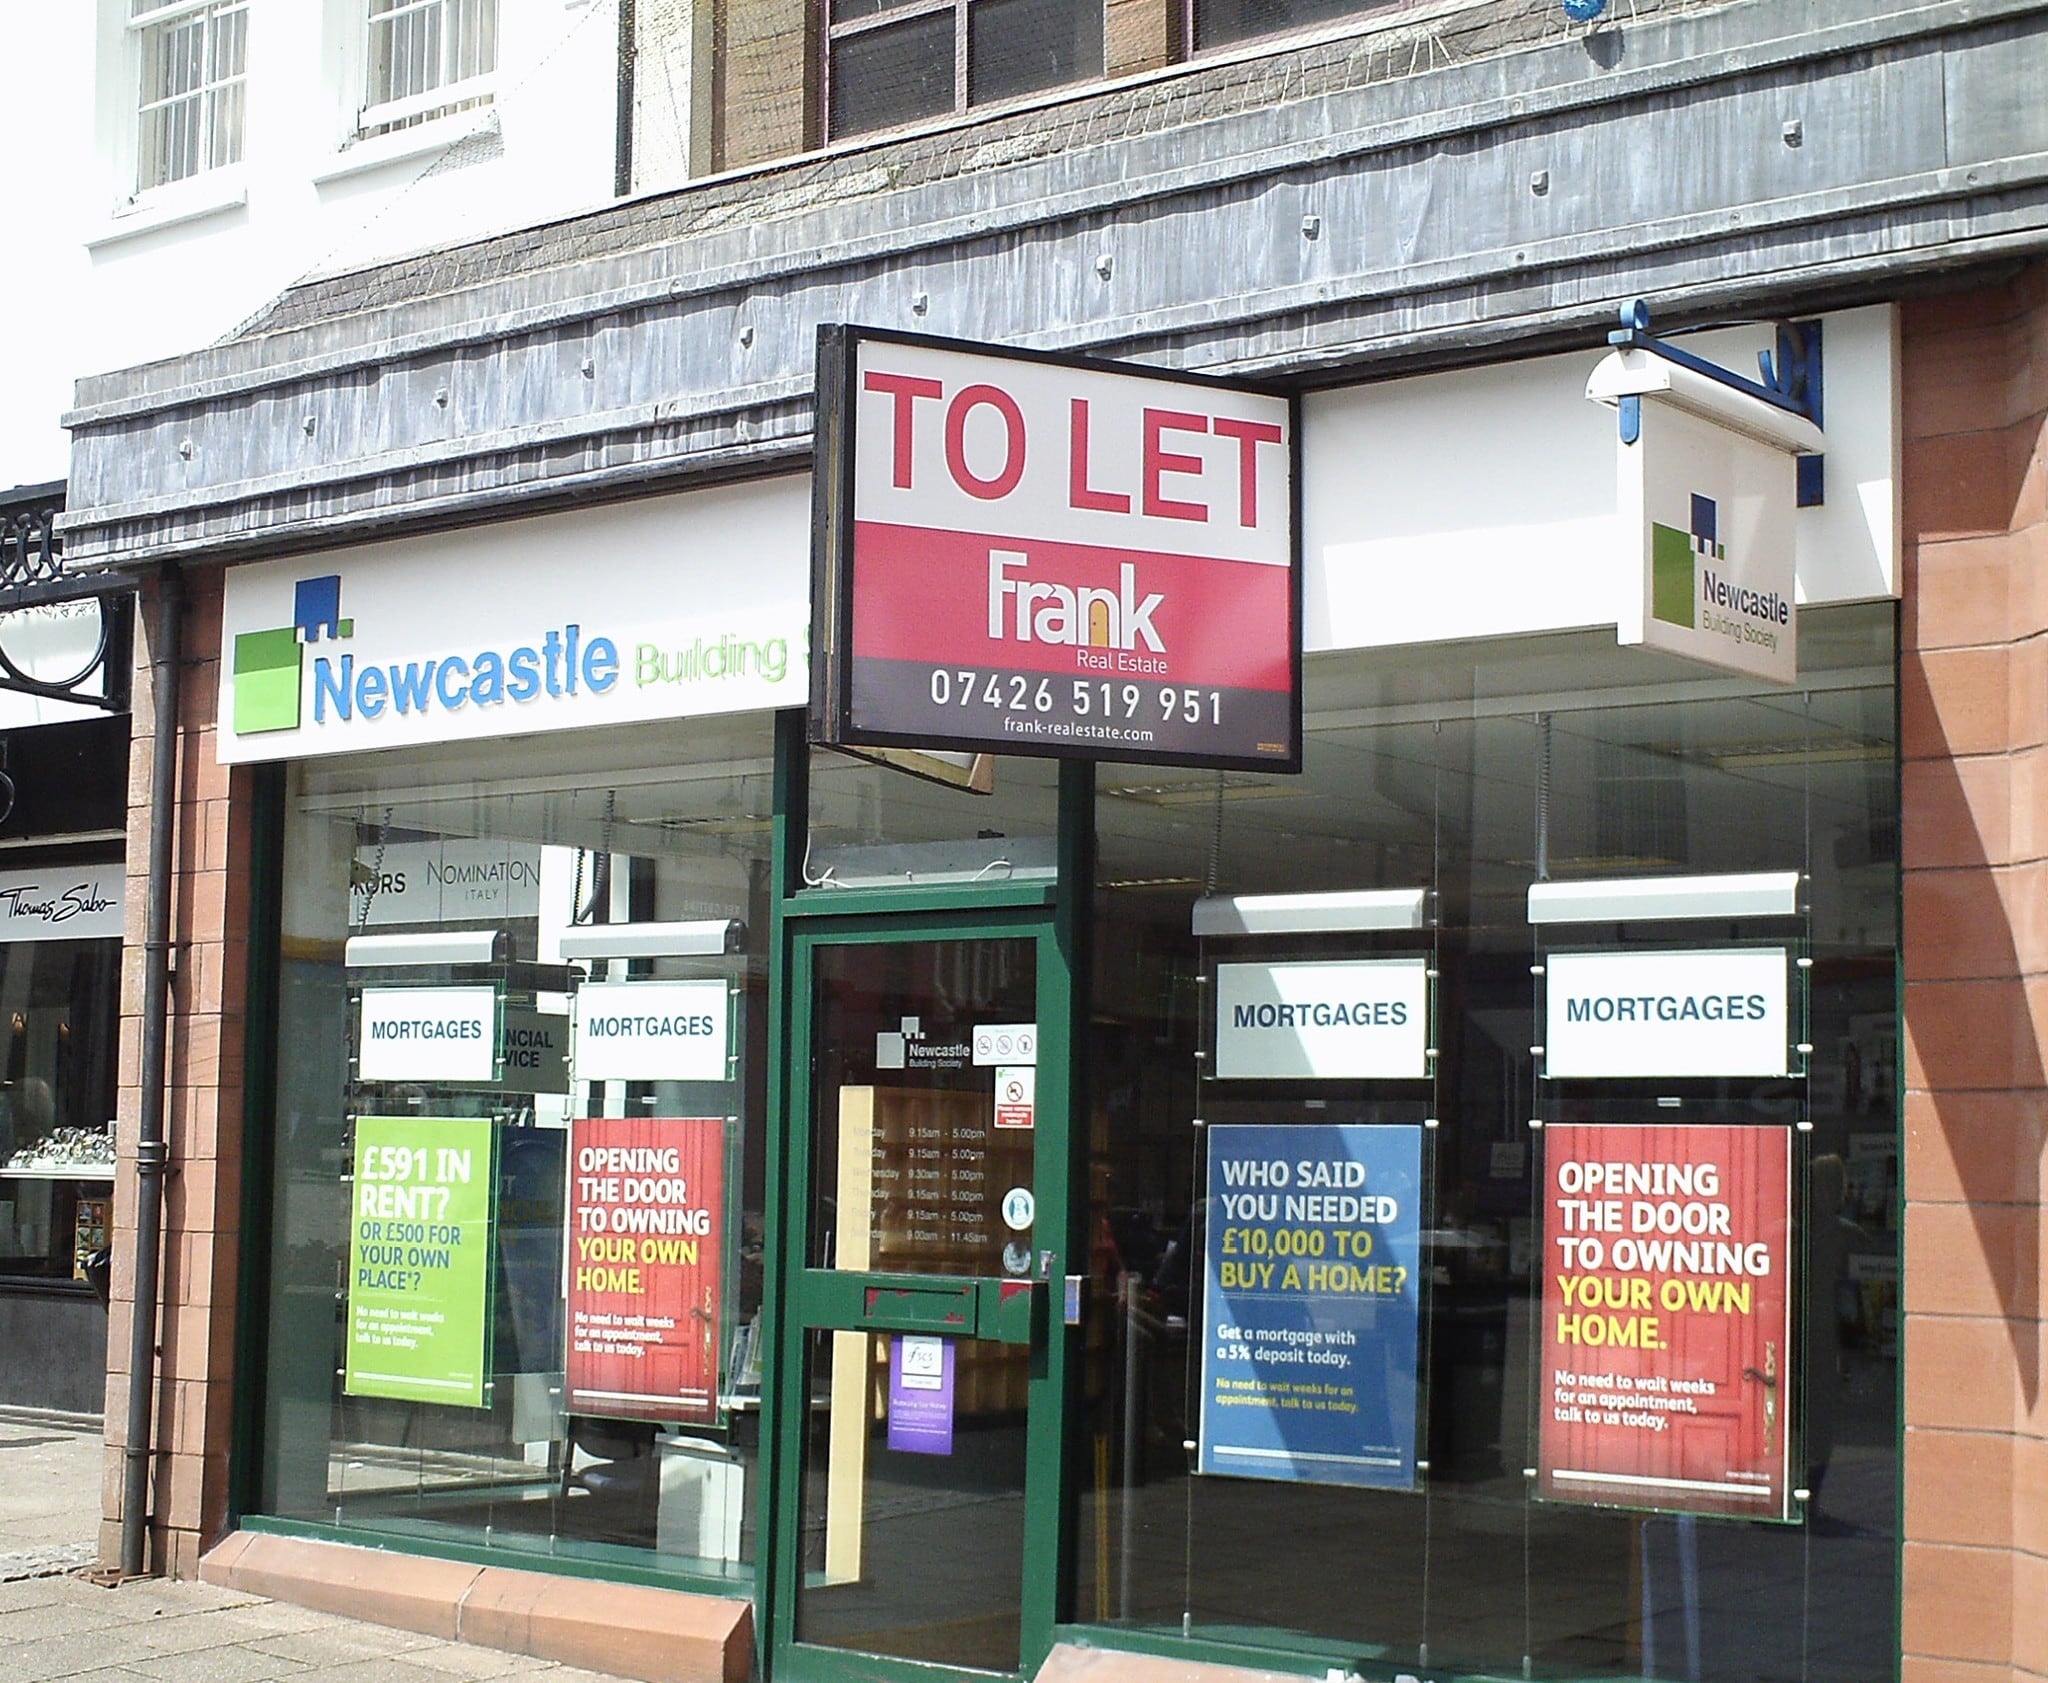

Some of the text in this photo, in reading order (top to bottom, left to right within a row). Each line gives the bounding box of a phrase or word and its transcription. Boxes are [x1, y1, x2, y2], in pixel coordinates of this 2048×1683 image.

[864, 371, 1282, 529] TO LET
[988, 549, 1166, 653] Frank
[1704, 570, 1789, 626] Newcastle
[1703, 610, 1779, 653] Building Society
[314, 623, 621, 724] Newcastle
[635, 632, 788, 690] Building
[1077, 649, 1168, 675] Real Estate
[931, 669, 1221, 725] 07426 519 951
[1003, 717, 1154, 743] frank-realestate.com
[0, 882, 117, 922] Thomas Sabo
[465, 888, 499, 900] ITALY
[1234, 1001, 1408, 1028] MORTGAGES
[1567, 994, 1766, 1023] MORTGAGES
[371, 1019, 483, 1040] MORTGAGES
[588, 1015, 714, 1038] MORTGAGES
[909, 1043, 970, 1058] Newcastle
[909, 1058, 962, 1069] Building Society
[909, 1127, 940, 1138] 9.15am
[952, 1128, 985, 1140] 5.00pm
[361, 1145, 472, 1184] £591 IN
[578, 1147, 680, 1174] OPENING
[908, 1148, 940, 1159] 9.15am
[952, 1149, 984, 1161] 5.00pm
[908, 1169, 939, 1180] 9.30am
[952, 1170, 984, 1182] 5.00pm
[1221, 1160, 1366, 1188] WHO SAID
[1558, 1161, 1719, 1197] OPENING
[359, 1183, 450, 1221] RENT?
[577, 1176, 686, 1205] THE DOOR
[907, 1188, 939, 1200] 9.15am
[952, 1190, 984, 1202] 5.00pm
[577, 1206, 711, 1236] TO OWNING
[907, 1209, 939, 1221] 9.15am
[951, 1211, 983, 1223] 5.00pm
[1221, 1194, 1399, 1225] YOU NEEDED
[1557, 1199, 1732, 1236] THE DOOR
[360, 1221, 461, 1245] OR £500 FOR
[906, 1229, 938, 1241] 9.00am
[1222, 1227, 1373, 1260] £10,000 TO
[360, 1245, 450, 1269] YOUR OWN
[577, 1236, 698, 1266] YOUR OWN
[1556, 1236, 1771, 1277] TO OWNING
[576, 1266, 646, 1294] HOME.
[1220, 1261, 1408, 1294] BUY A HOME?
[1556, 1274, 1751, 1315] YOUR OWN
[574, 1311, 675, 1329] No need to wait weeks
[1557, 1312, 1668, 1350] HOME.
[574, 1325, 663, 1344] for an appointment,
[1217, 1323, 1356, 1347] Get a mortgage with
[574, 1339, 646, 1358] talk to us today.
[1216, 1345, 1351, 1369] a 5% deposit today.
[1216, 1377, 1353, 1395] No need to wait weeks for an
[1554, 1370, 1716, 1395] No need to wait weeks
[1215, 1394, 1358, 1414] appointment, talk to us today.
[1554, 1388, 1698, 1415] for an appointment,
[1554, 1406, 1669, 1432] talk to us today.
